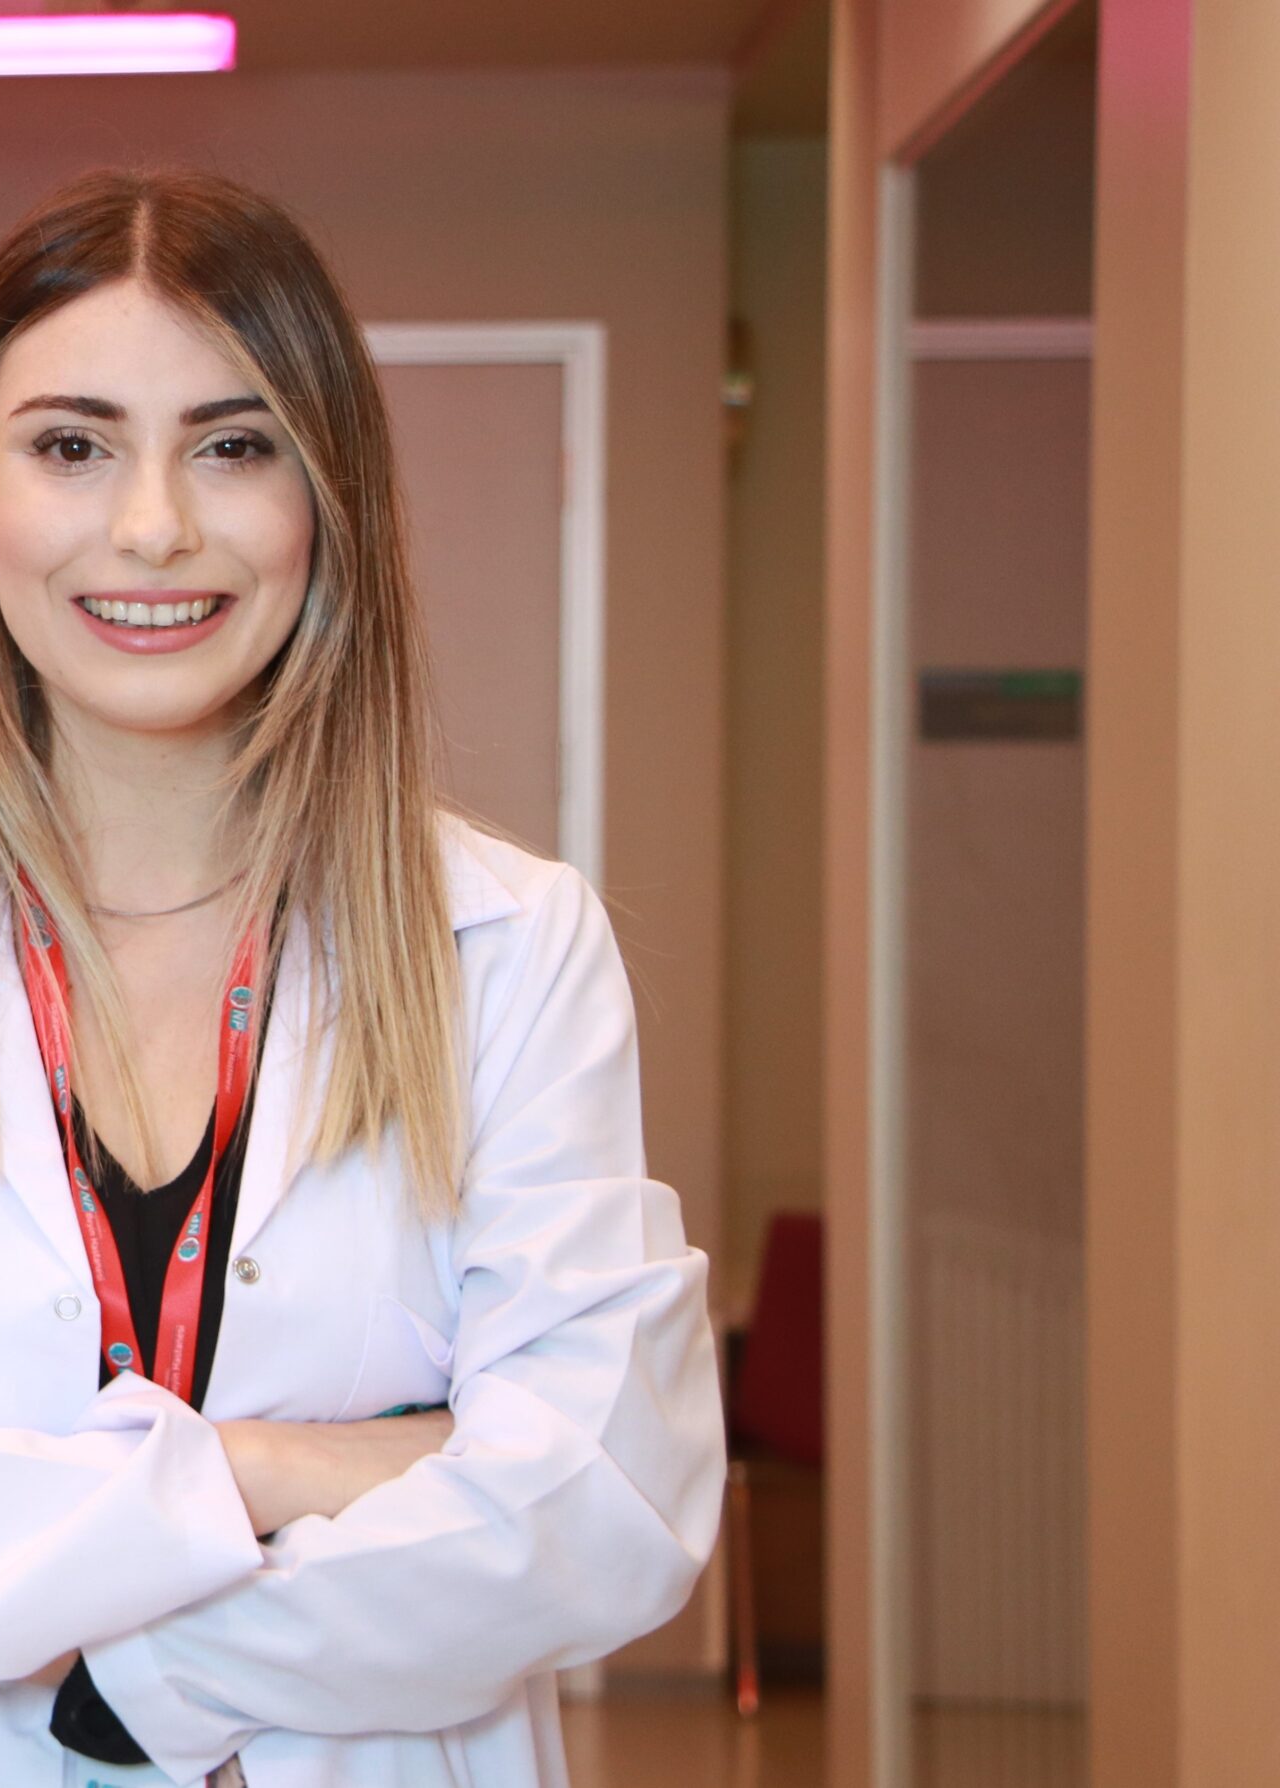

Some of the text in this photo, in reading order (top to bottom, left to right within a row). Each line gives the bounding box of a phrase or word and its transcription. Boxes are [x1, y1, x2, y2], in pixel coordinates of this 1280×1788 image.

[229, 1009, 247, 1031] NP
[80, 1191, 96, 1212] NP
[91, 1238, 105, 1281] Hastanesi
[187, 1213, 201, 1234] NP
[172, 1325, 185, 1371] Hastanesi
